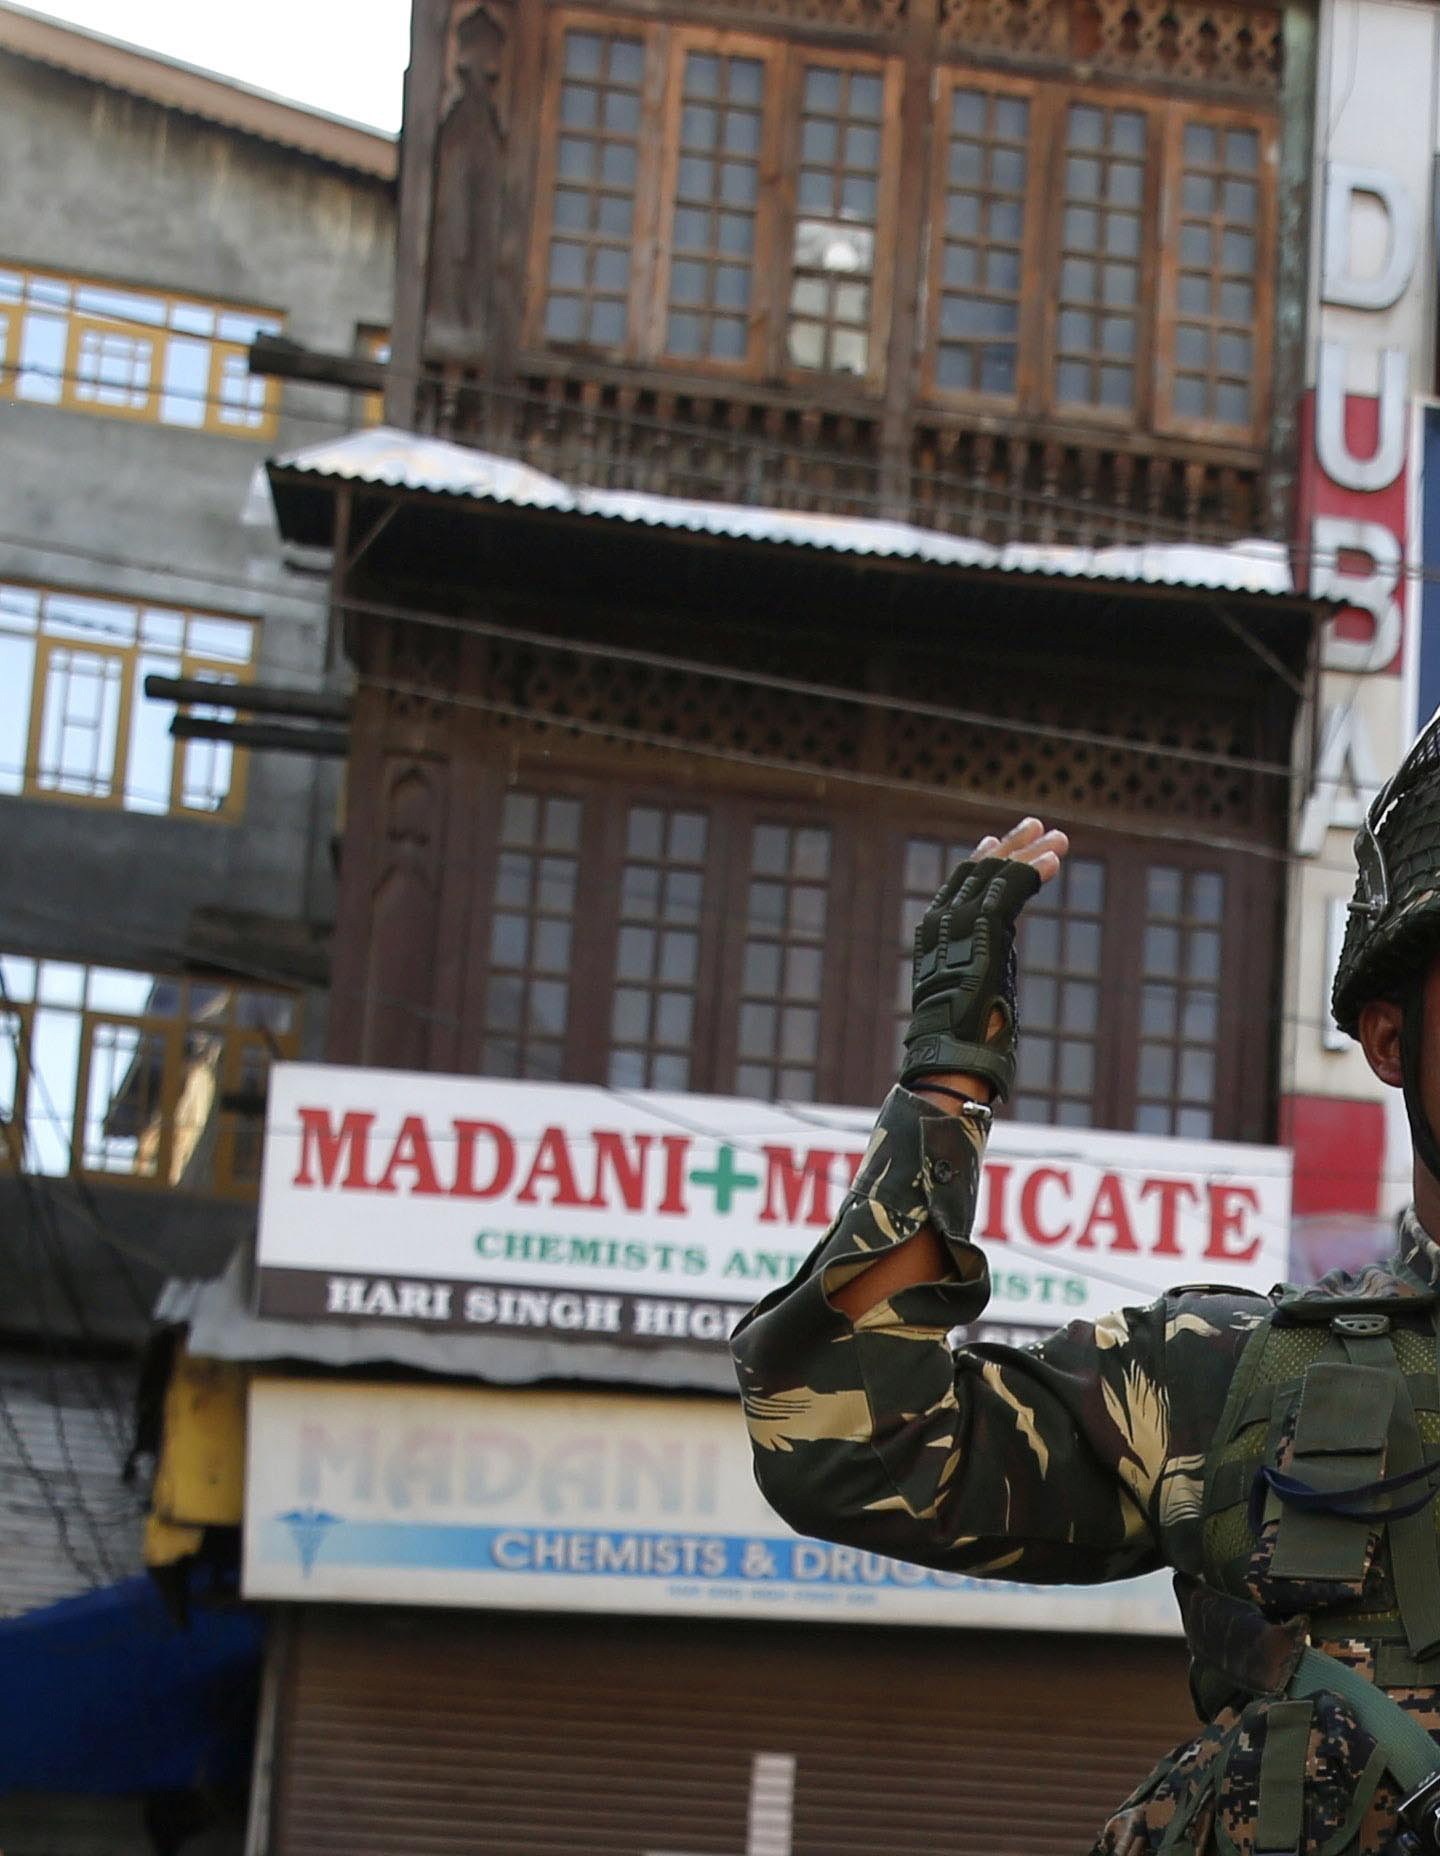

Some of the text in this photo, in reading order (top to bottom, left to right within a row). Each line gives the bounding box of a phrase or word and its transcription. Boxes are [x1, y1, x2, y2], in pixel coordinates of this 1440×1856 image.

[292, 1106, 1262, 1266] MADANI MICATE
[474, 1228, 708, 1278] CHEMISTS
[326, 1277, 455, 1320] HARI
[464, 1286, 623, 1332] SINGH
[298, 1419, 721, 1517] MADANI
[490, 1529, 728, 1577] CHEMISTS
[742, 1542, 777, 1579] &
